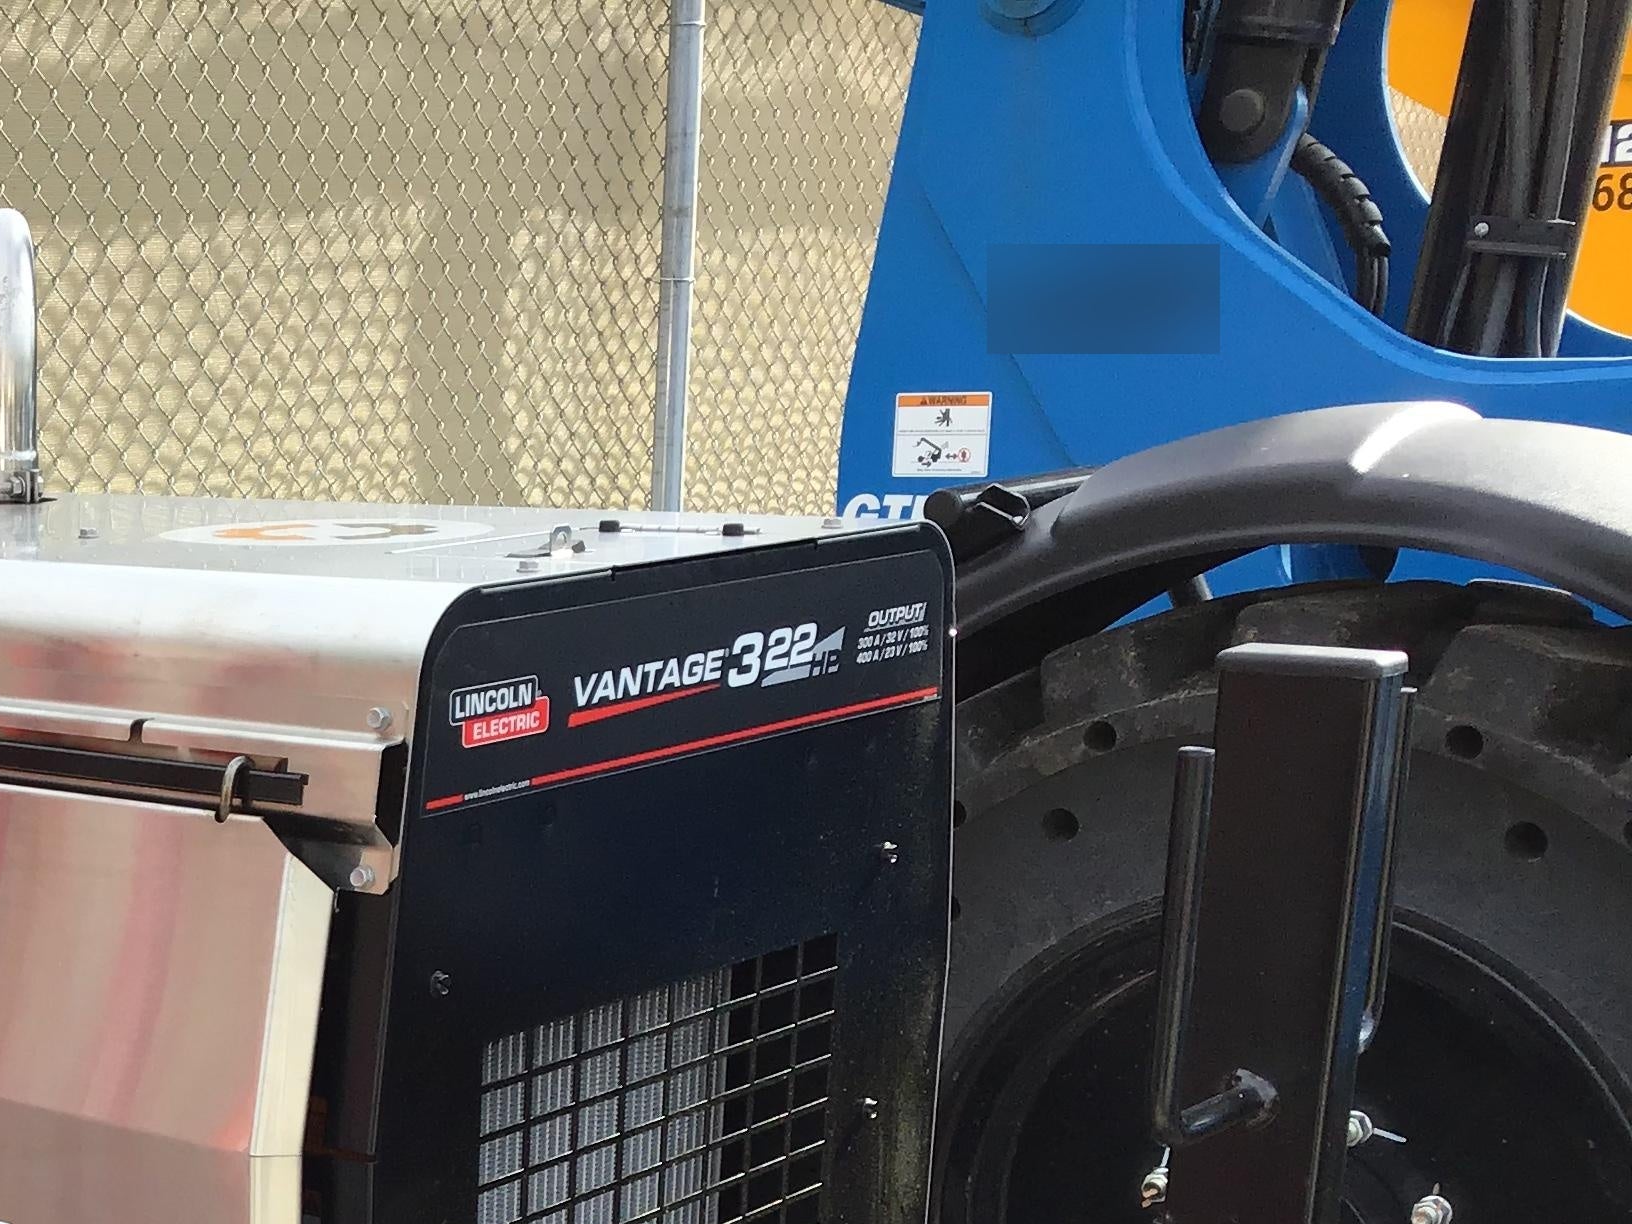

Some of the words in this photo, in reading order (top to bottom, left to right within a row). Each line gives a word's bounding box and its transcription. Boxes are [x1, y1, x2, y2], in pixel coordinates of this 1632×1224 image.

[868, 603, 924, 627] OUTPUT
[573, 648, 725, 707] VANTAGE
[728, 622, 818, 688] 322
[455, 683, 533, 719] LINCOLN
[473, 711, 540, 740] ELECTRIC
